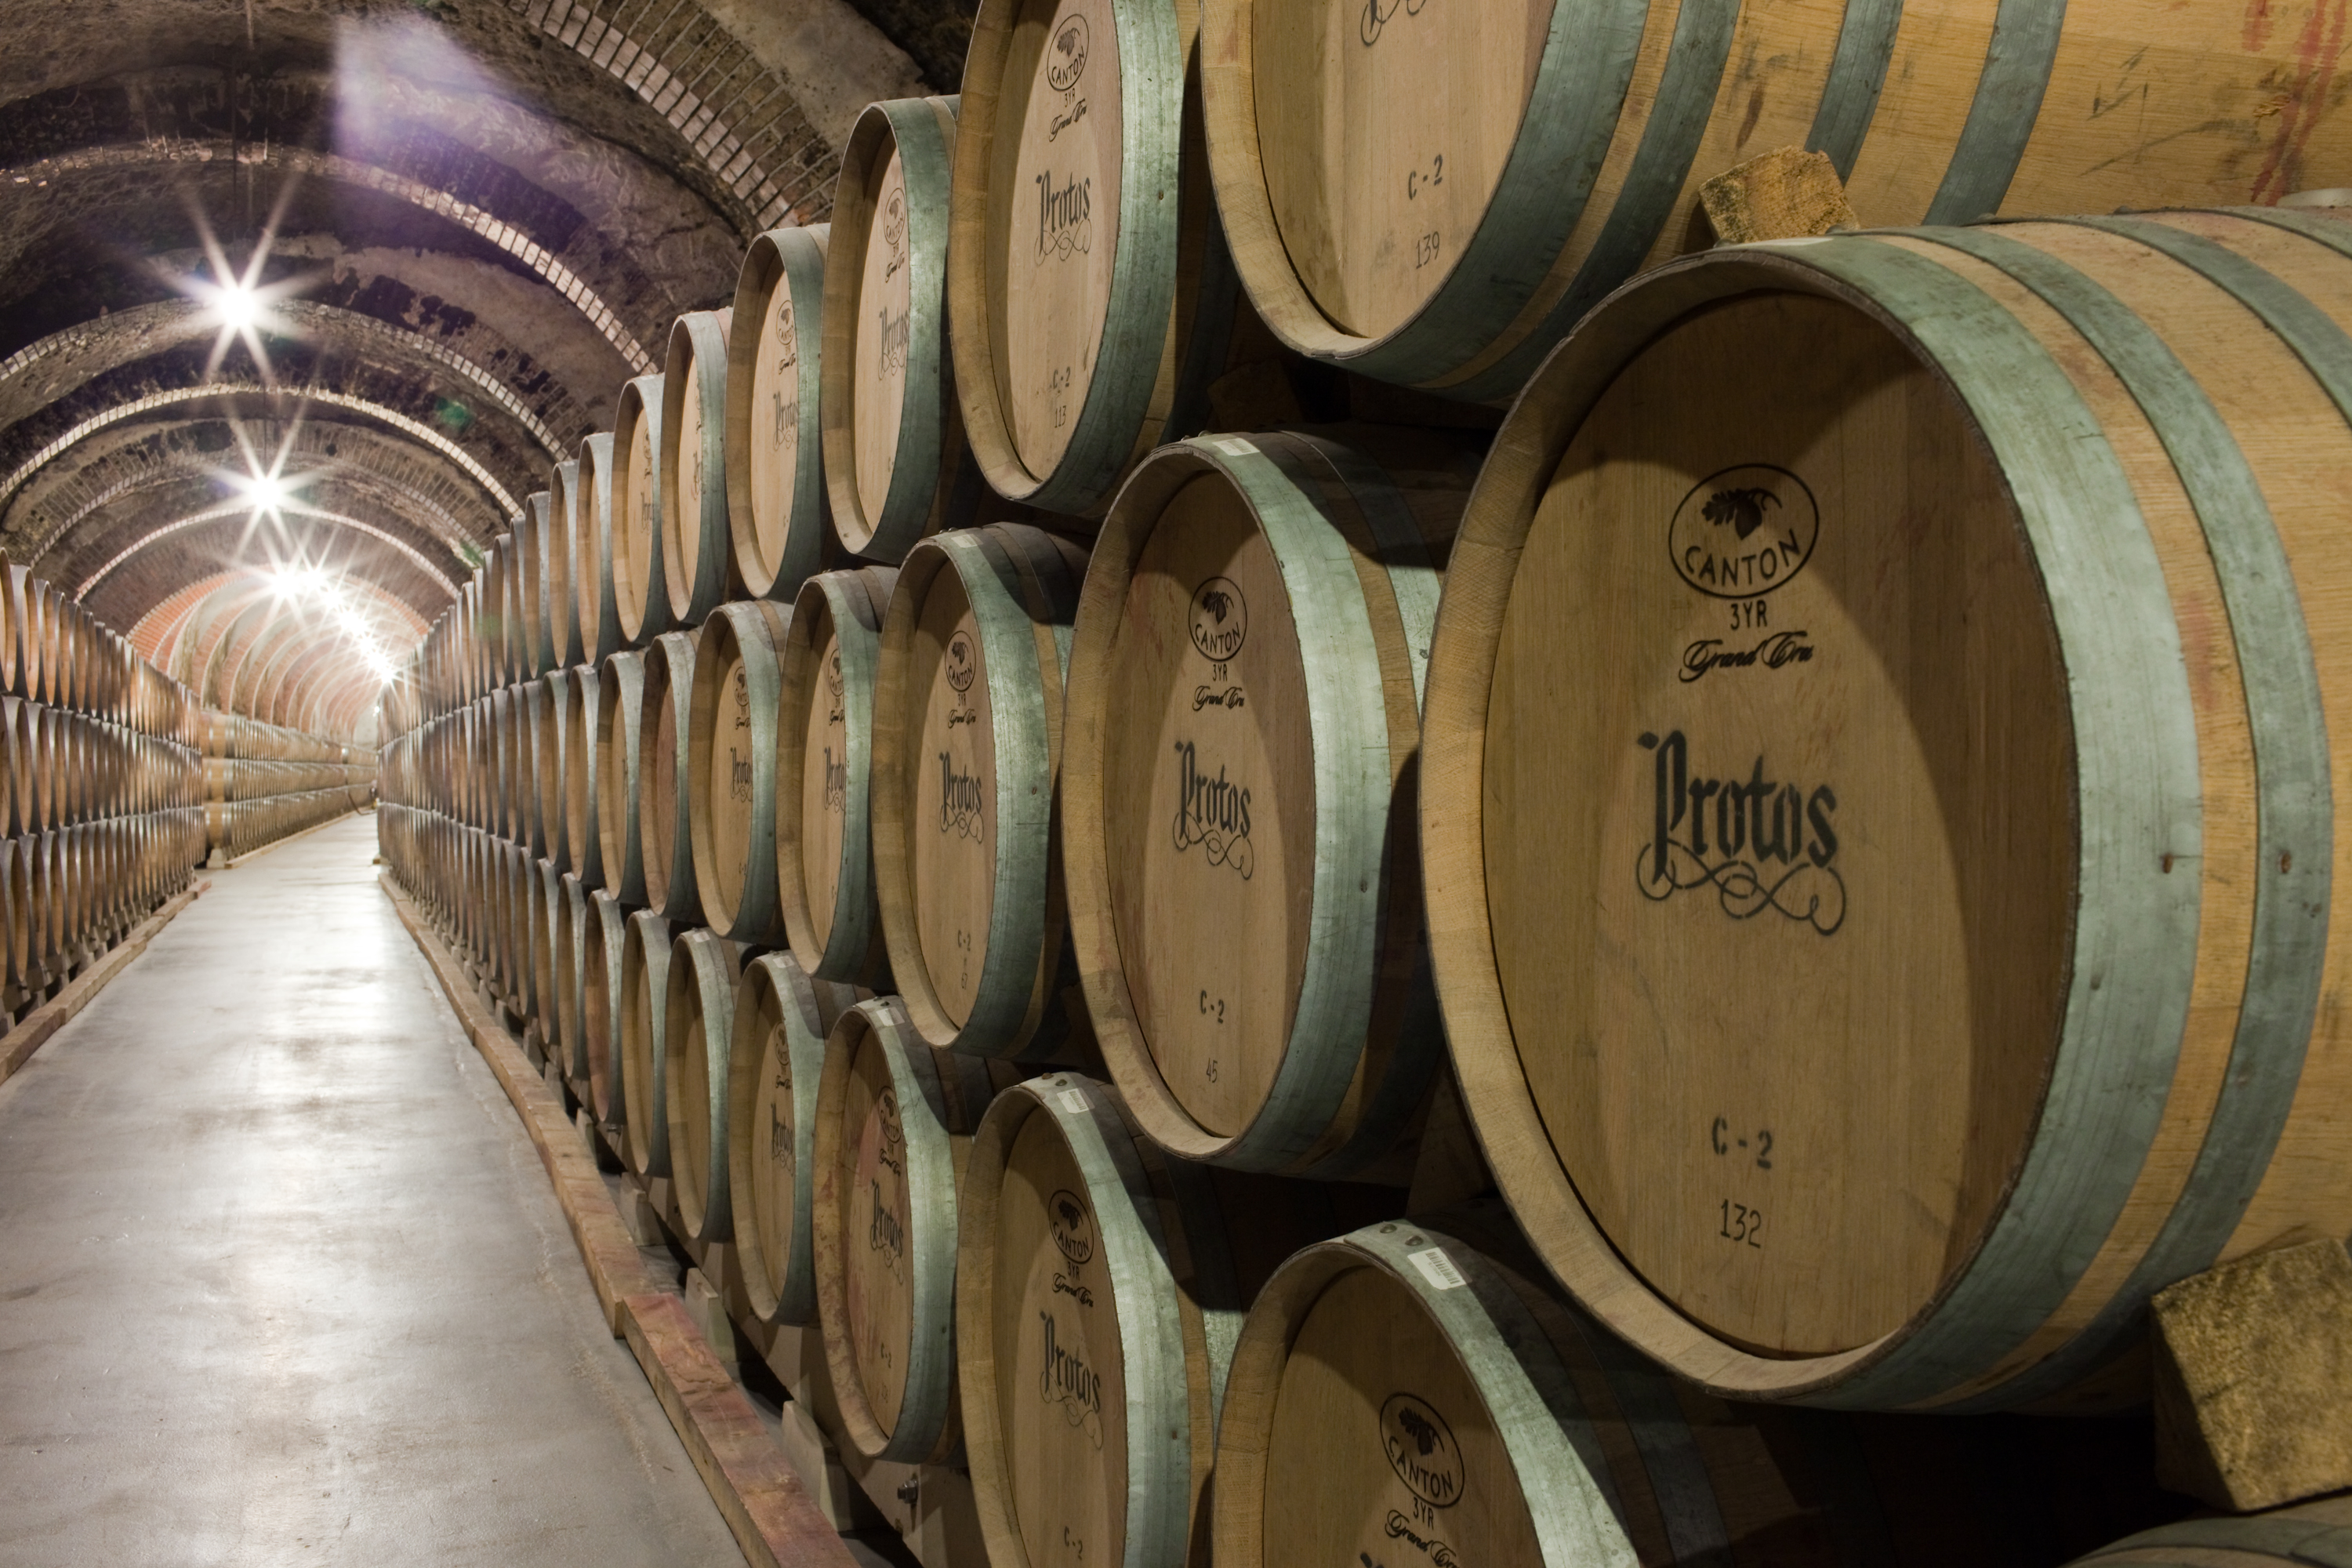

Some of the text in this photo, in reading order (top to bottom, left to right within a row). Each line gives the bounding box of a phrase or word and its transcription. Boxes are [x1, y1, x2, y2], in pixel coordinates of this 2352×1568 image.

[1051, 45, 1085, 85] CANTON
[1065, 88, 1076, 107] 3YR
[1408, 154, 1443, 201] C-2
[1034, 169, 1091, 263] Protos
[1415, 230, 1441, 270] 139
[1052, 365, 1072, 390] C-2
[1054, 405, 1067, 428] 113
[1685, 528, 1802, 586] CANTON
[1730, 600, 1768, 630] 3YR
[1196, 621, 1241, 655] CANTON
[1679, 630, 1815, 683] Grand Cru
[948, 662, 973, 687] CANTON
[1212, 663, 1229, 682] 3YR
[1192, 685, 1245, 712] Grand Cru
[730, 746, 753, 797] Proto
[824, 746, 845, 809] Proto
[938, 751, 983, 831] Protos
[1174, 741, 1252, 851] Protos
[1637, 730, 1839, 902] Protos
[1200, 989, 1225, 1024] C-2
[1206, 1057, 1218, 1083] 45
[1711, 1116, 1773, 1171] C-2
[1053, 1221, 1090, 1258] CANTON
[1719, 1198, 1762, 1250] 132
[1067, 1261, 1080, 1281] 3YR
[1039, 1311, 1102, 1416] Protos
[1389, 1436, 1454, 1499] CANTON
[1385, 1509, 1433, 1553] Grand
[1413, 1497, 1435, 1530] 3YR
